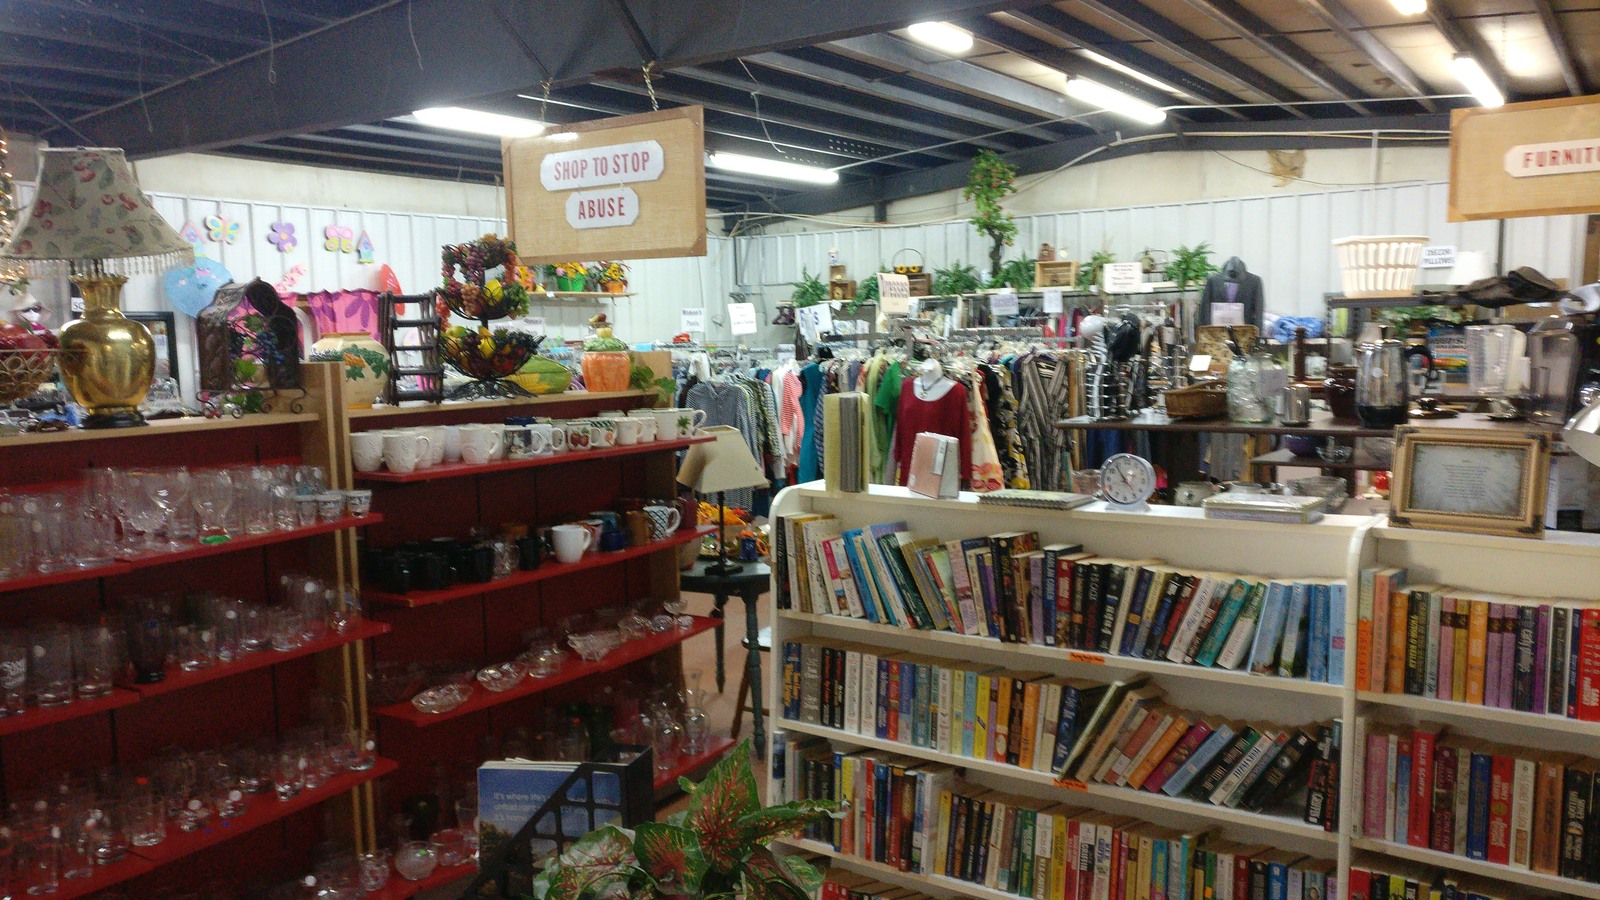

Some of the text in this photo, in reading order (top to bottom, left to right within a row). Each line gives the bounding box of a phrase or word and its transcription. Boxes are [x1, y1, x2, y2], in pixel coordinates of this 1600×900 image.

[554, 151, 650, 181] SHOP TO STOP
[1523, 146, 1600, 168] FURNIT
[578, 197, 626, 220] ABUSE
[1046, 552, 1055, 600] HARLAN COBEN
[1517, 647, 1534, 672] phillips
[1492, 775, 1501, 800] SHELDON
[1501, 782, 1509, 801] SIDNEY
[1569, 791, 1577, 819] SHELDON
[1576, 799, 1586, 820] SIDNEY
[1080, 844, 1089, 871] GRIFFIN
[1097, 838, 1105, 864] GRIFFIN
